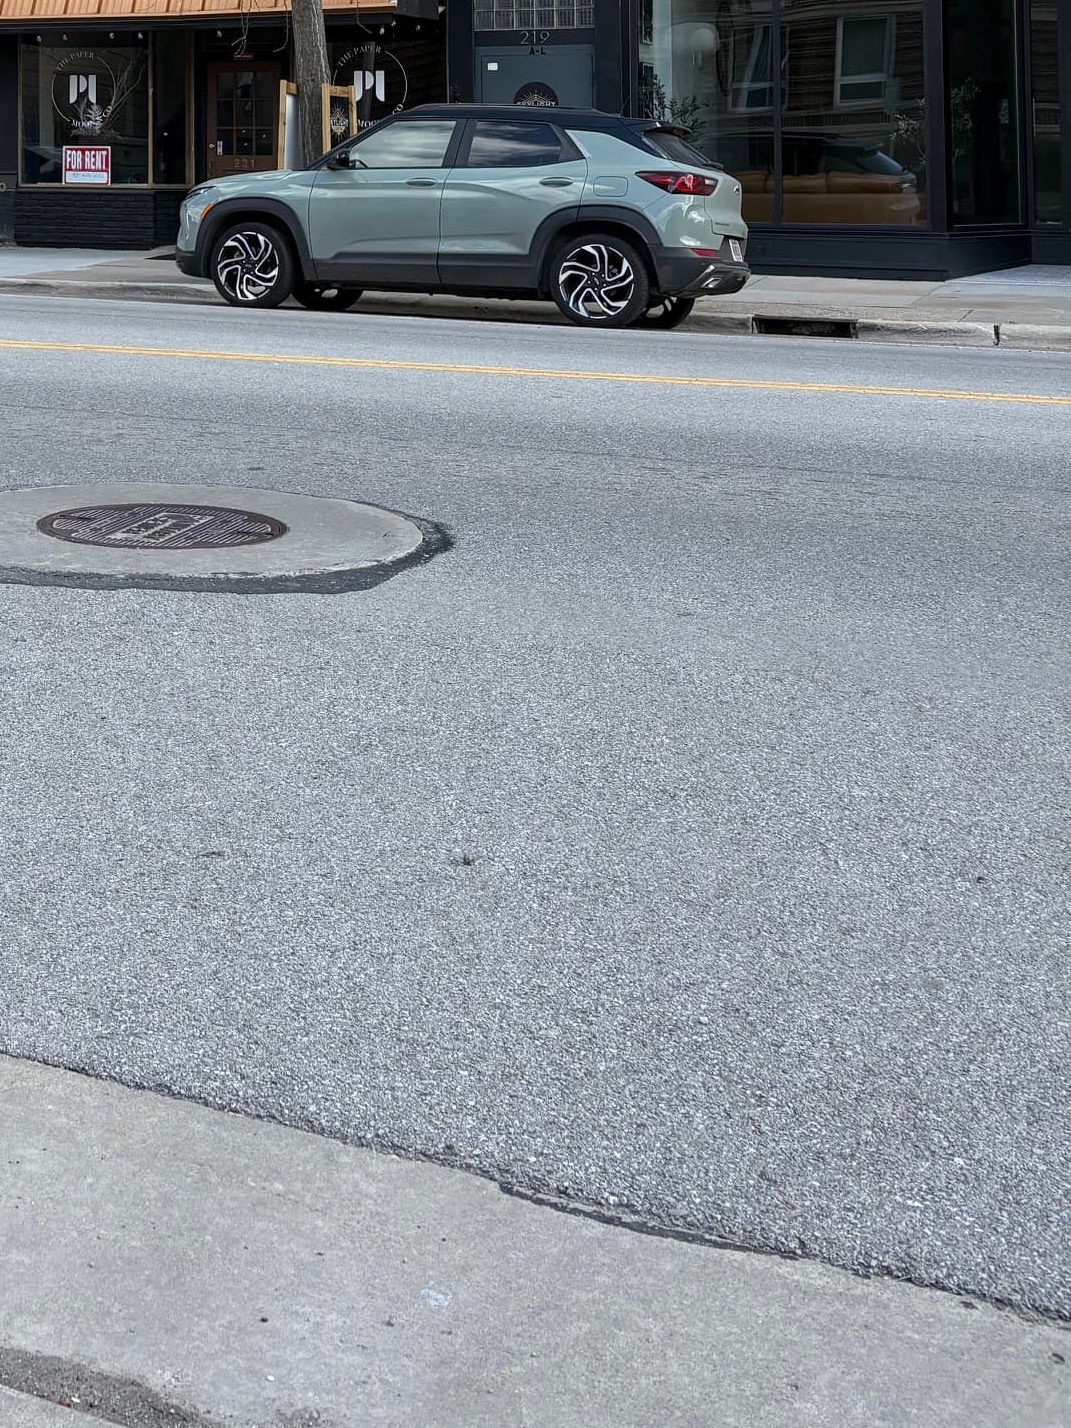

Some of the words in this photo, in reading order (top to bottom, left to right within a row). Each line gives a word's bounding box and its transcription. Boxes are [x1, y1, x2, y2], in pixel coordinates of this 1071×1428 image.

[520, 31, 550, 45] 219
[70, 51, 95, 60] PAPER
[337, 51, 354, 67] THE
[353, 44, 382, 55] PAPER
[529, 46, 546, 55] A-L
[66, 150, 82, 170] FOR
[85, 150, 107, 170] RENT
[233, 158, 255, 168] 221
